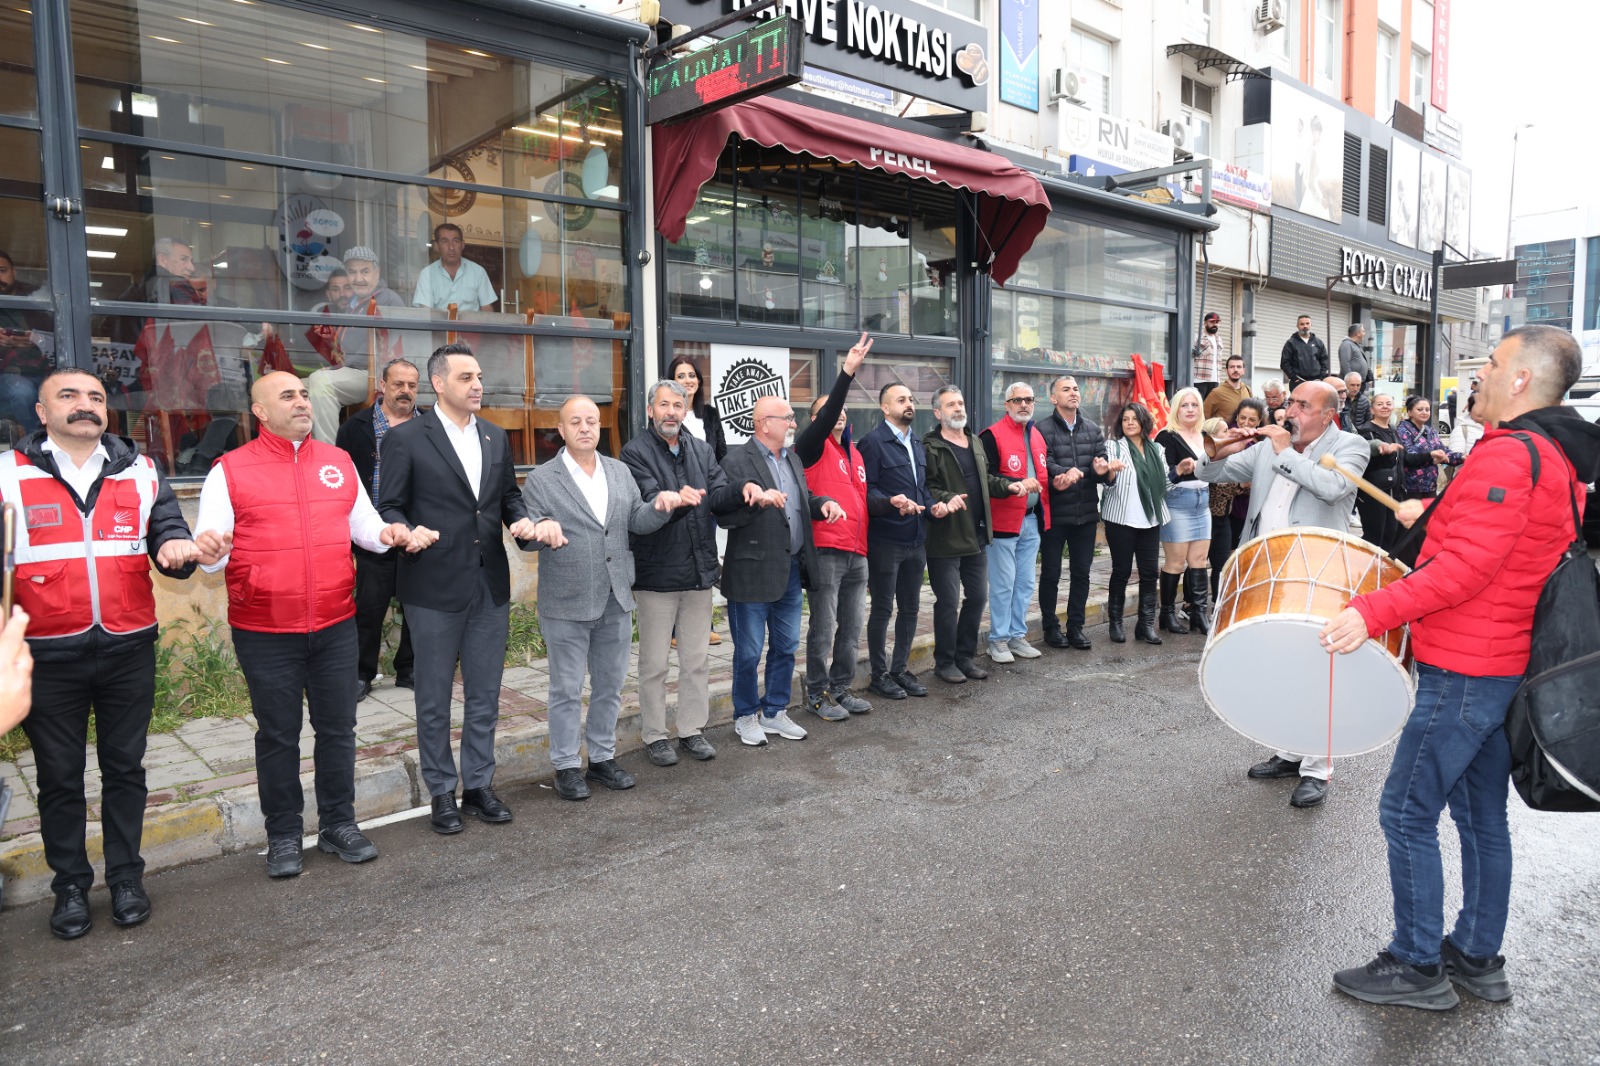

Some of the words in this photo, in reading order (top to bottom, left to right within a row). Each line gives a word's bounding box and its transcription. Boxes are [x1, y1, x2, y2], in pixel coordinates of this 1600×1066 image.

[732, 0, 837, 42] HVE
[847, 1, 953, 79] NOKTASI
[1098, 117, 1129, 151] RN
[870, 146, 937, 175] PEKEL
[1225, 162, 1249, 181] AKTAŞ
[1341, 246, 1388, 291] FOTO
[729, 370, 745, 388] TAKE
[746, 368, 765, 381] AWAY
[719, 391, 749, 415] TAKE
[738, 416, 754, 429] TAKE
[114, 525, 133, 533] CHP
